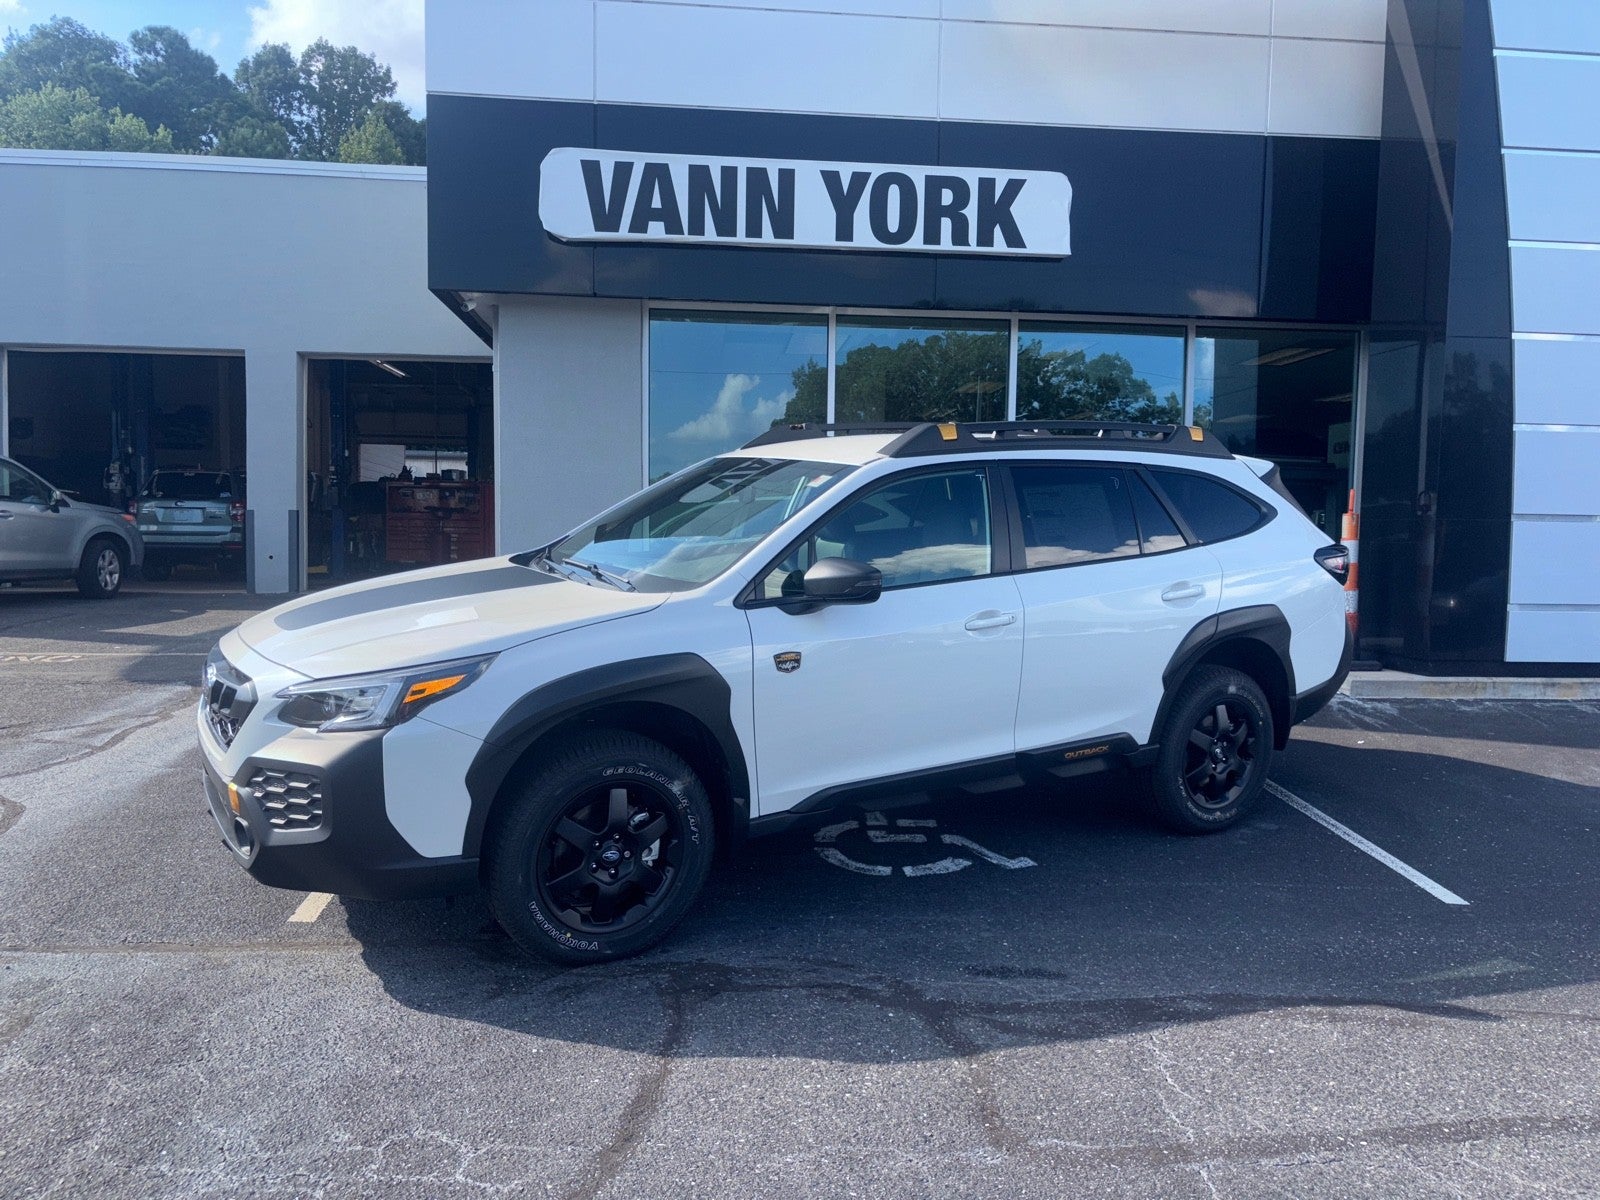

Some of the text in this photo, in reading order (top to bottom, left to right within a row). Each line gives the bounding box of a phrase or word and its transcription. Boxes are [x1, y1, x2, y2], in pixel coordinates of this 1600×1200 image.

[580, 159, 1028, 249] VANN YORK
[1064, 745, 1109, 759] OUTBACK
[528, 900, 599, 951] YOKOHAMA
